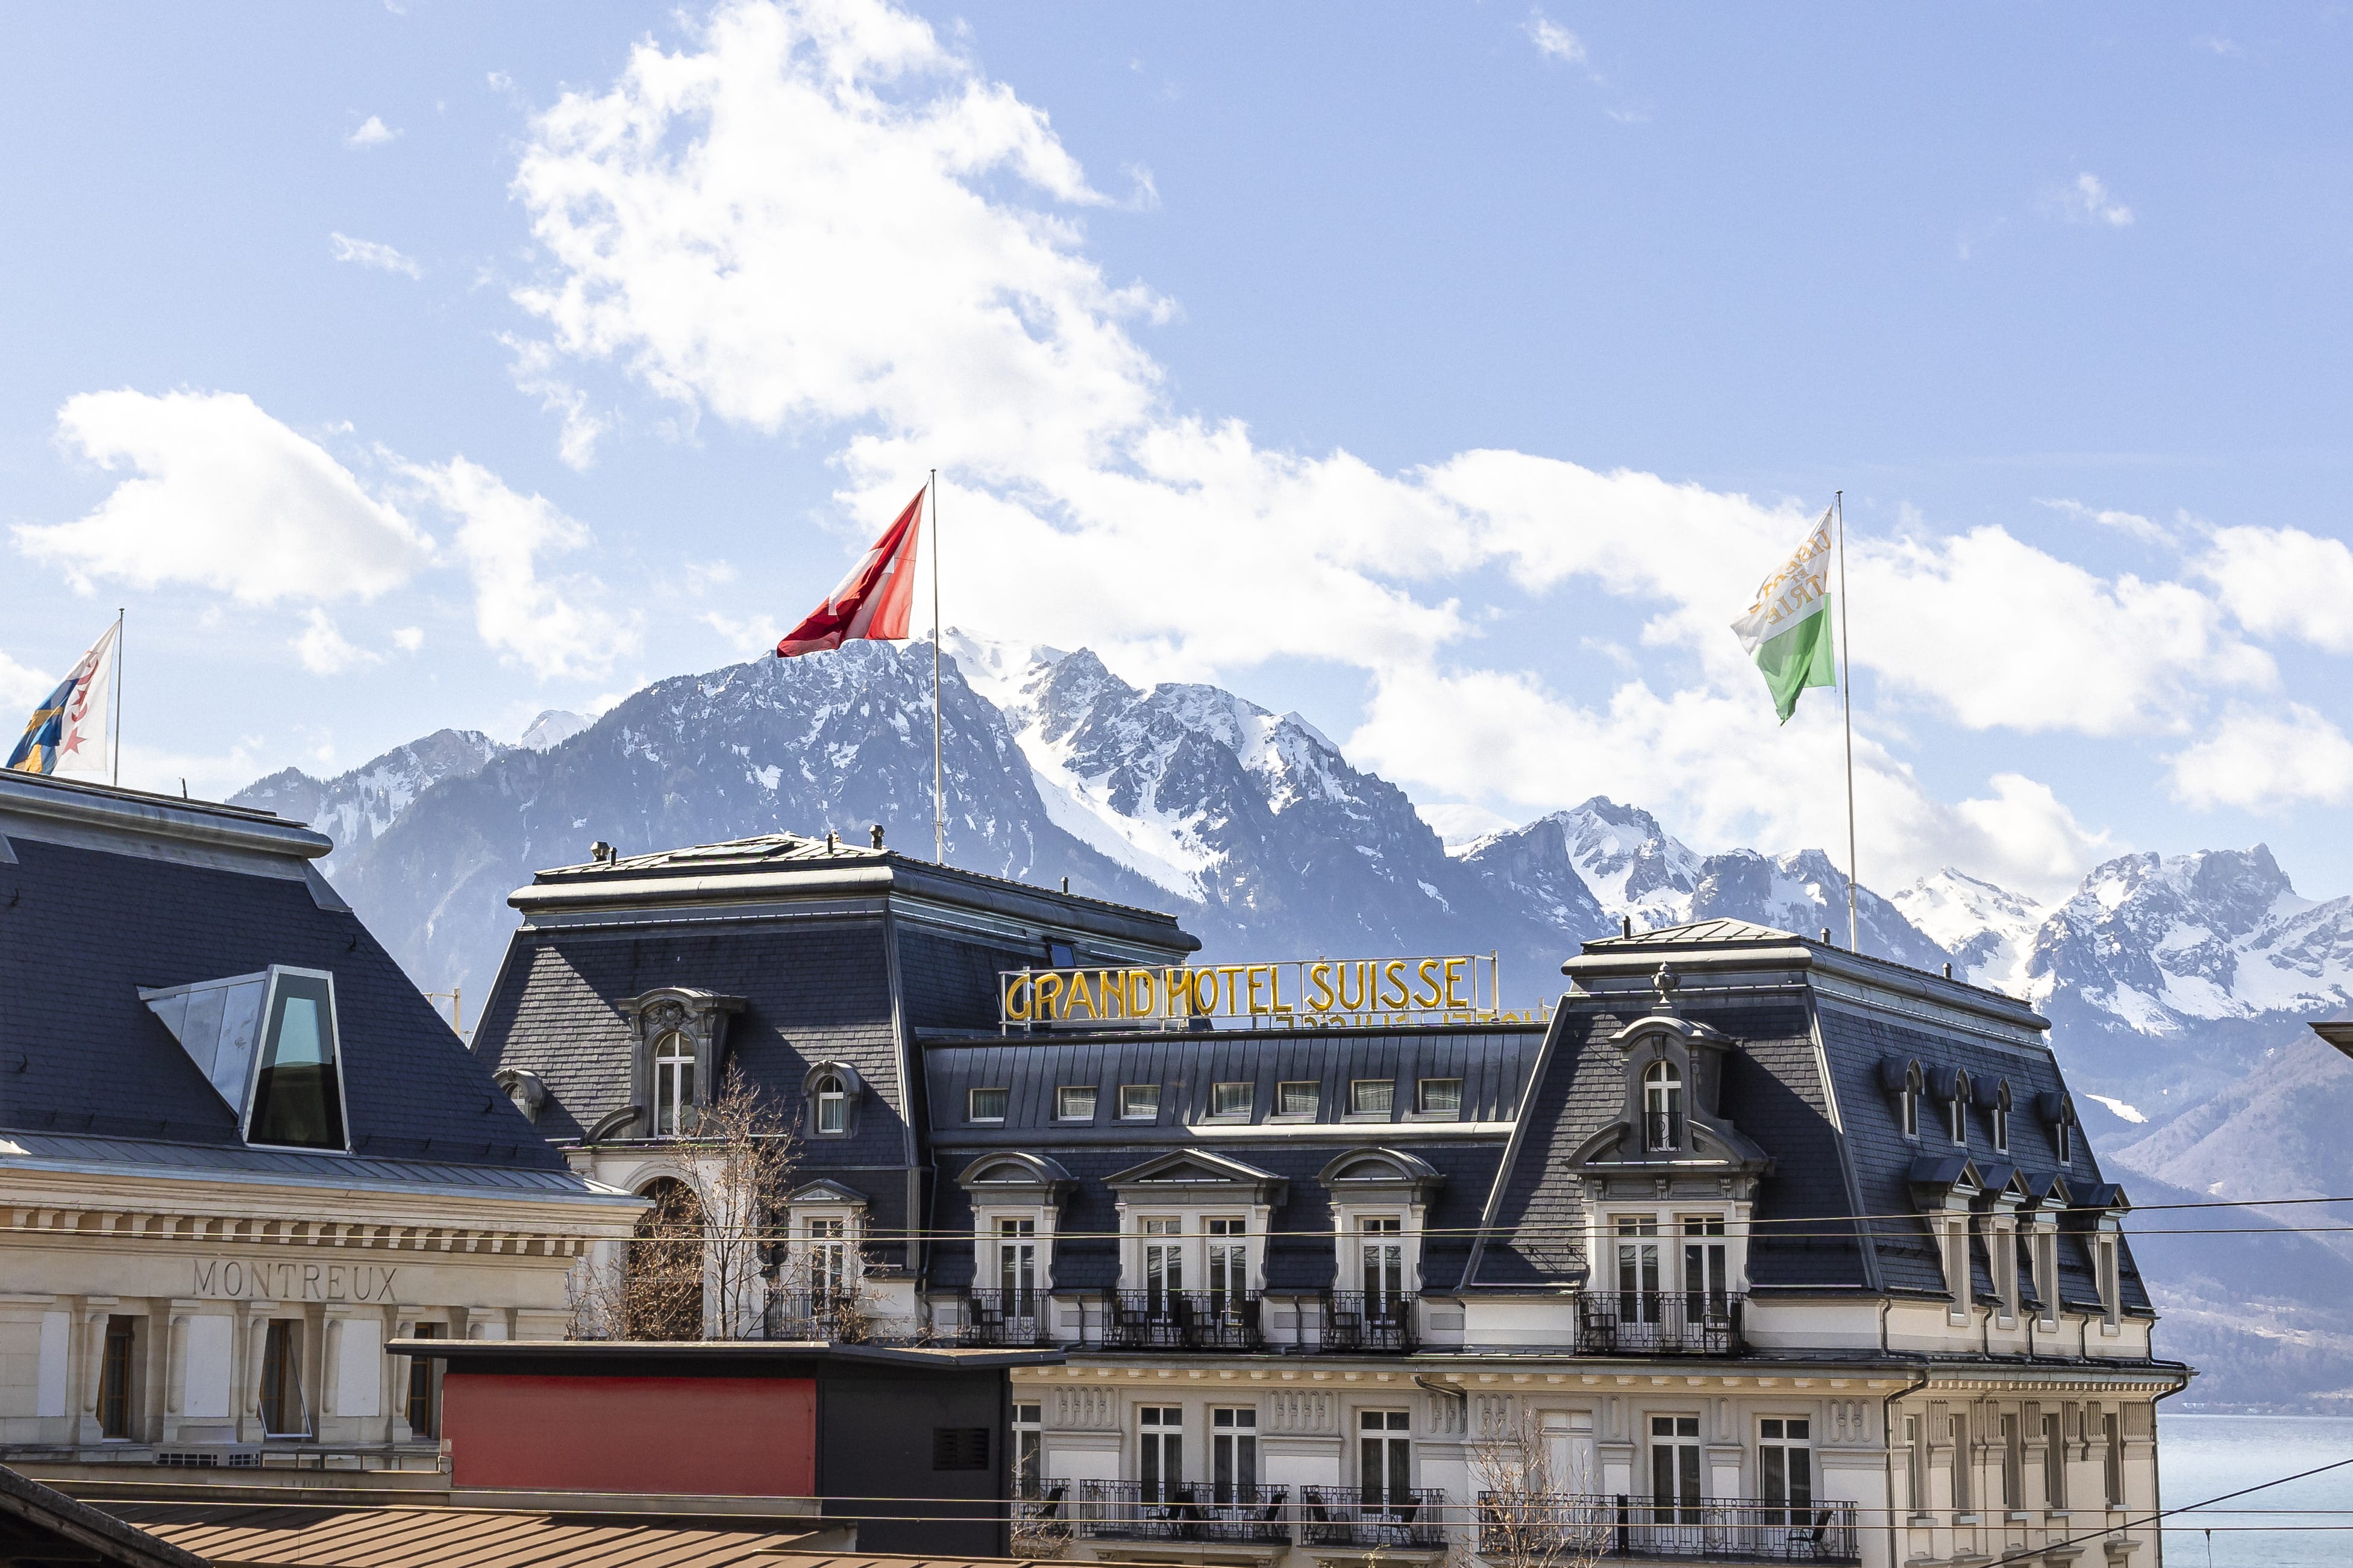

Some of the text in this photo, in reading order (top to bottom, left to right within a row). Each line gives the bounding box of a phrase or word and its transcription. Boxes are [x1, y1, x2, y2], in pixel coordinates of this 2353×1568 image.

[1006, 958, 1468, 1020] GRAND HOTEL SUISSE
[192, 1259, 398, 1302] MONTREUX
